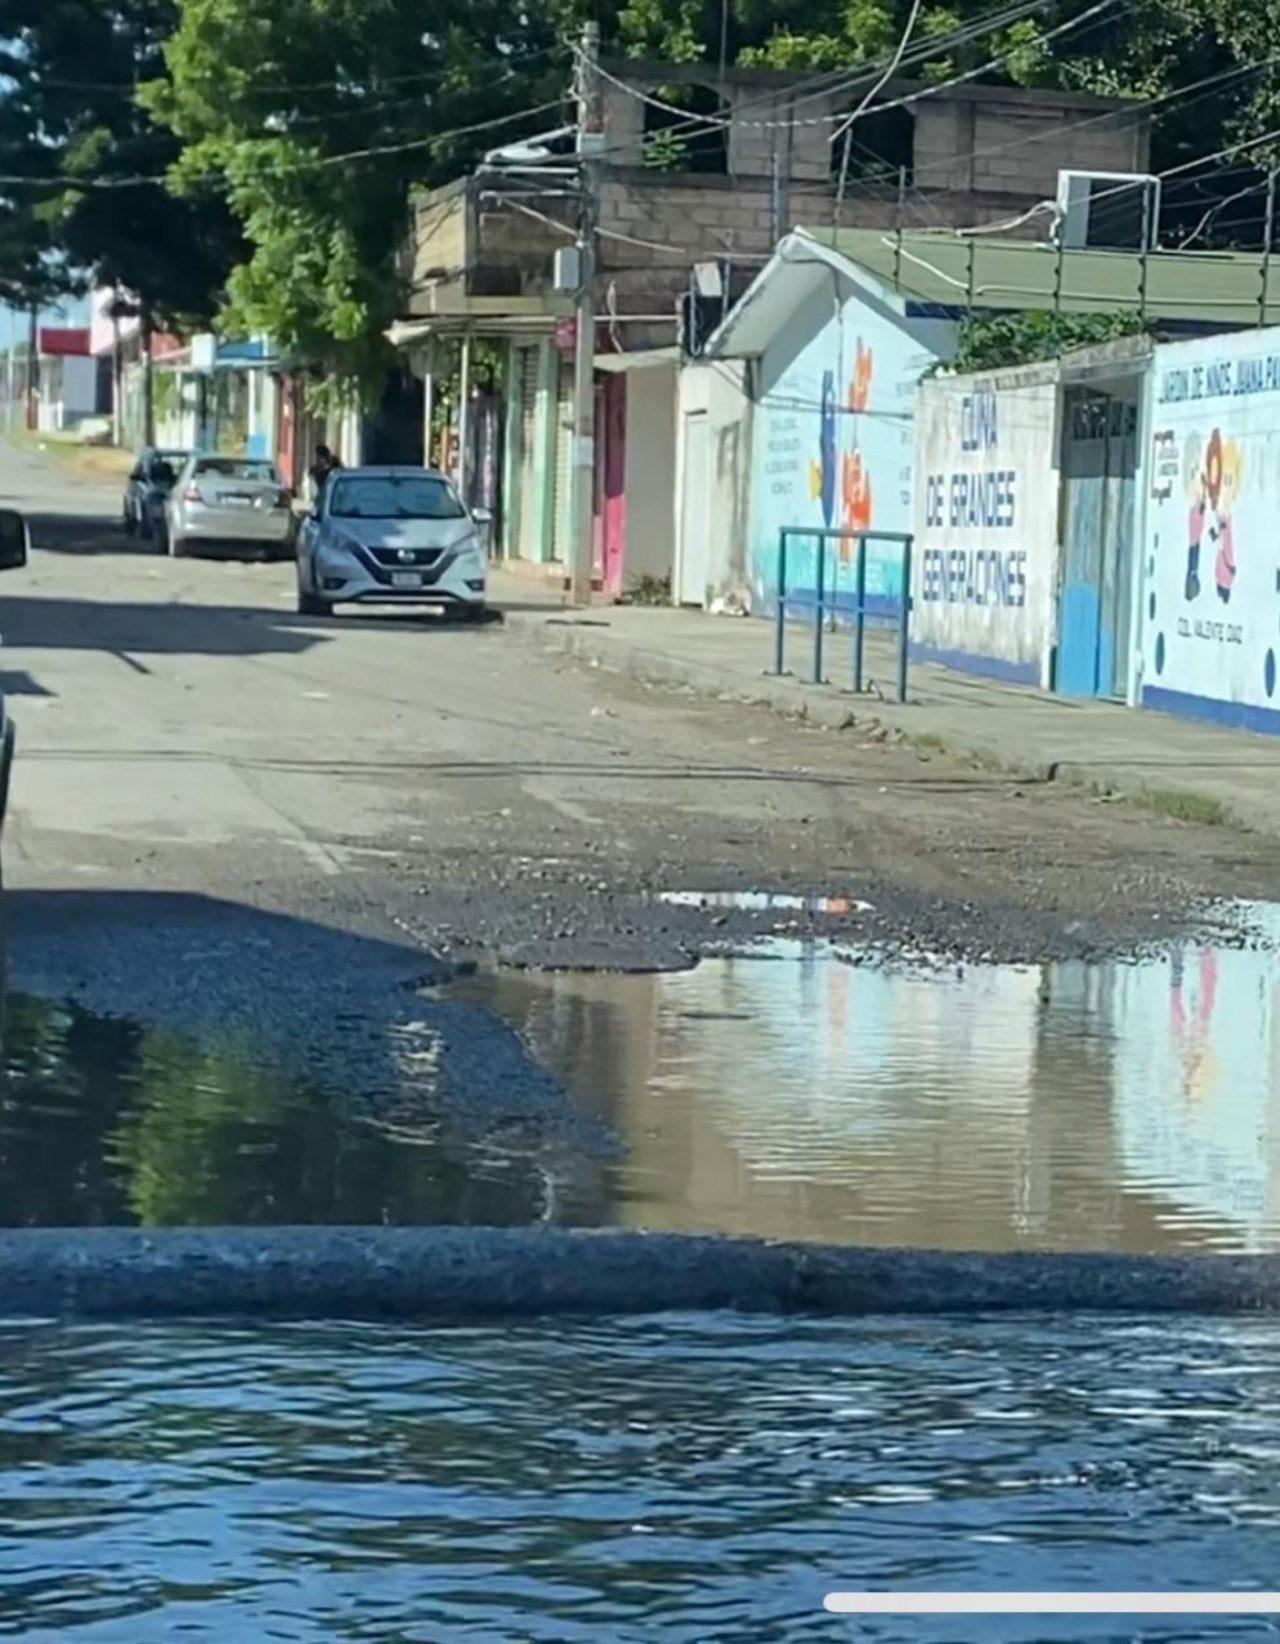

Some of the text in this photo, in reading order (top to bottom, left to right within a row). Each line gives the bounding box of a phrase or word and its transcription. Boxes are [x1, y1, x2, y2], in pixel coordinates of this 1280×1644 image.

[1190, 366, 1203, 399] DE
[926, 469, 1016, 527] DE GRANDES
[923, 549, 1027, 607] GENERACIONES
